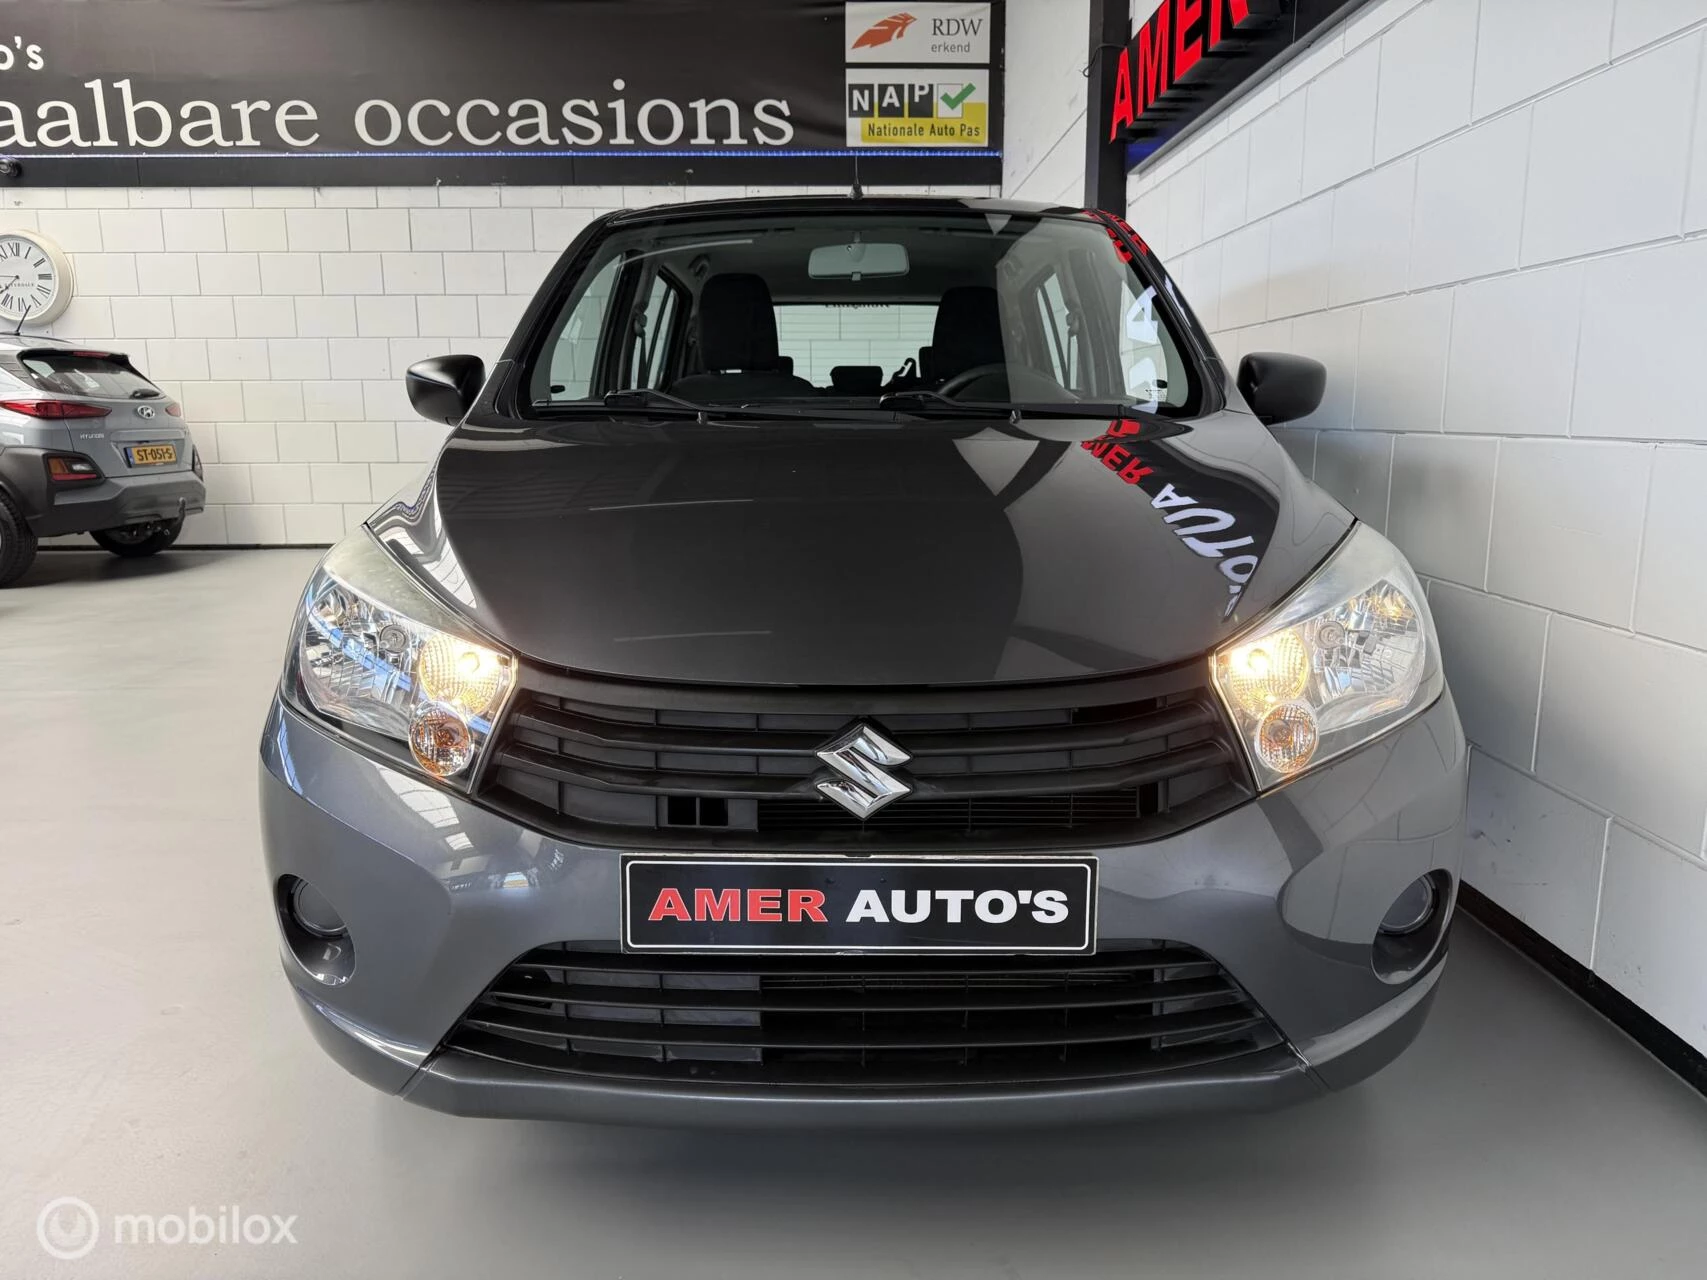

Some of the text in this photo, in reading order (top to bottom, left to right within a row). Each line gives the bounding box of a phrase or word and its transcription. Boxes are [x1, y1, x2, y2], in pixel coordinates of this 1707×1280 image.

[932, 18, 983, 36] RDW
[931, 42, 971, 53] erkend
[354, 78, 795, 147] occasions
[868, 123, 980, 137] Nationale Auto Pas
[648, 888, 1069, 924] AMER AUTO'S
